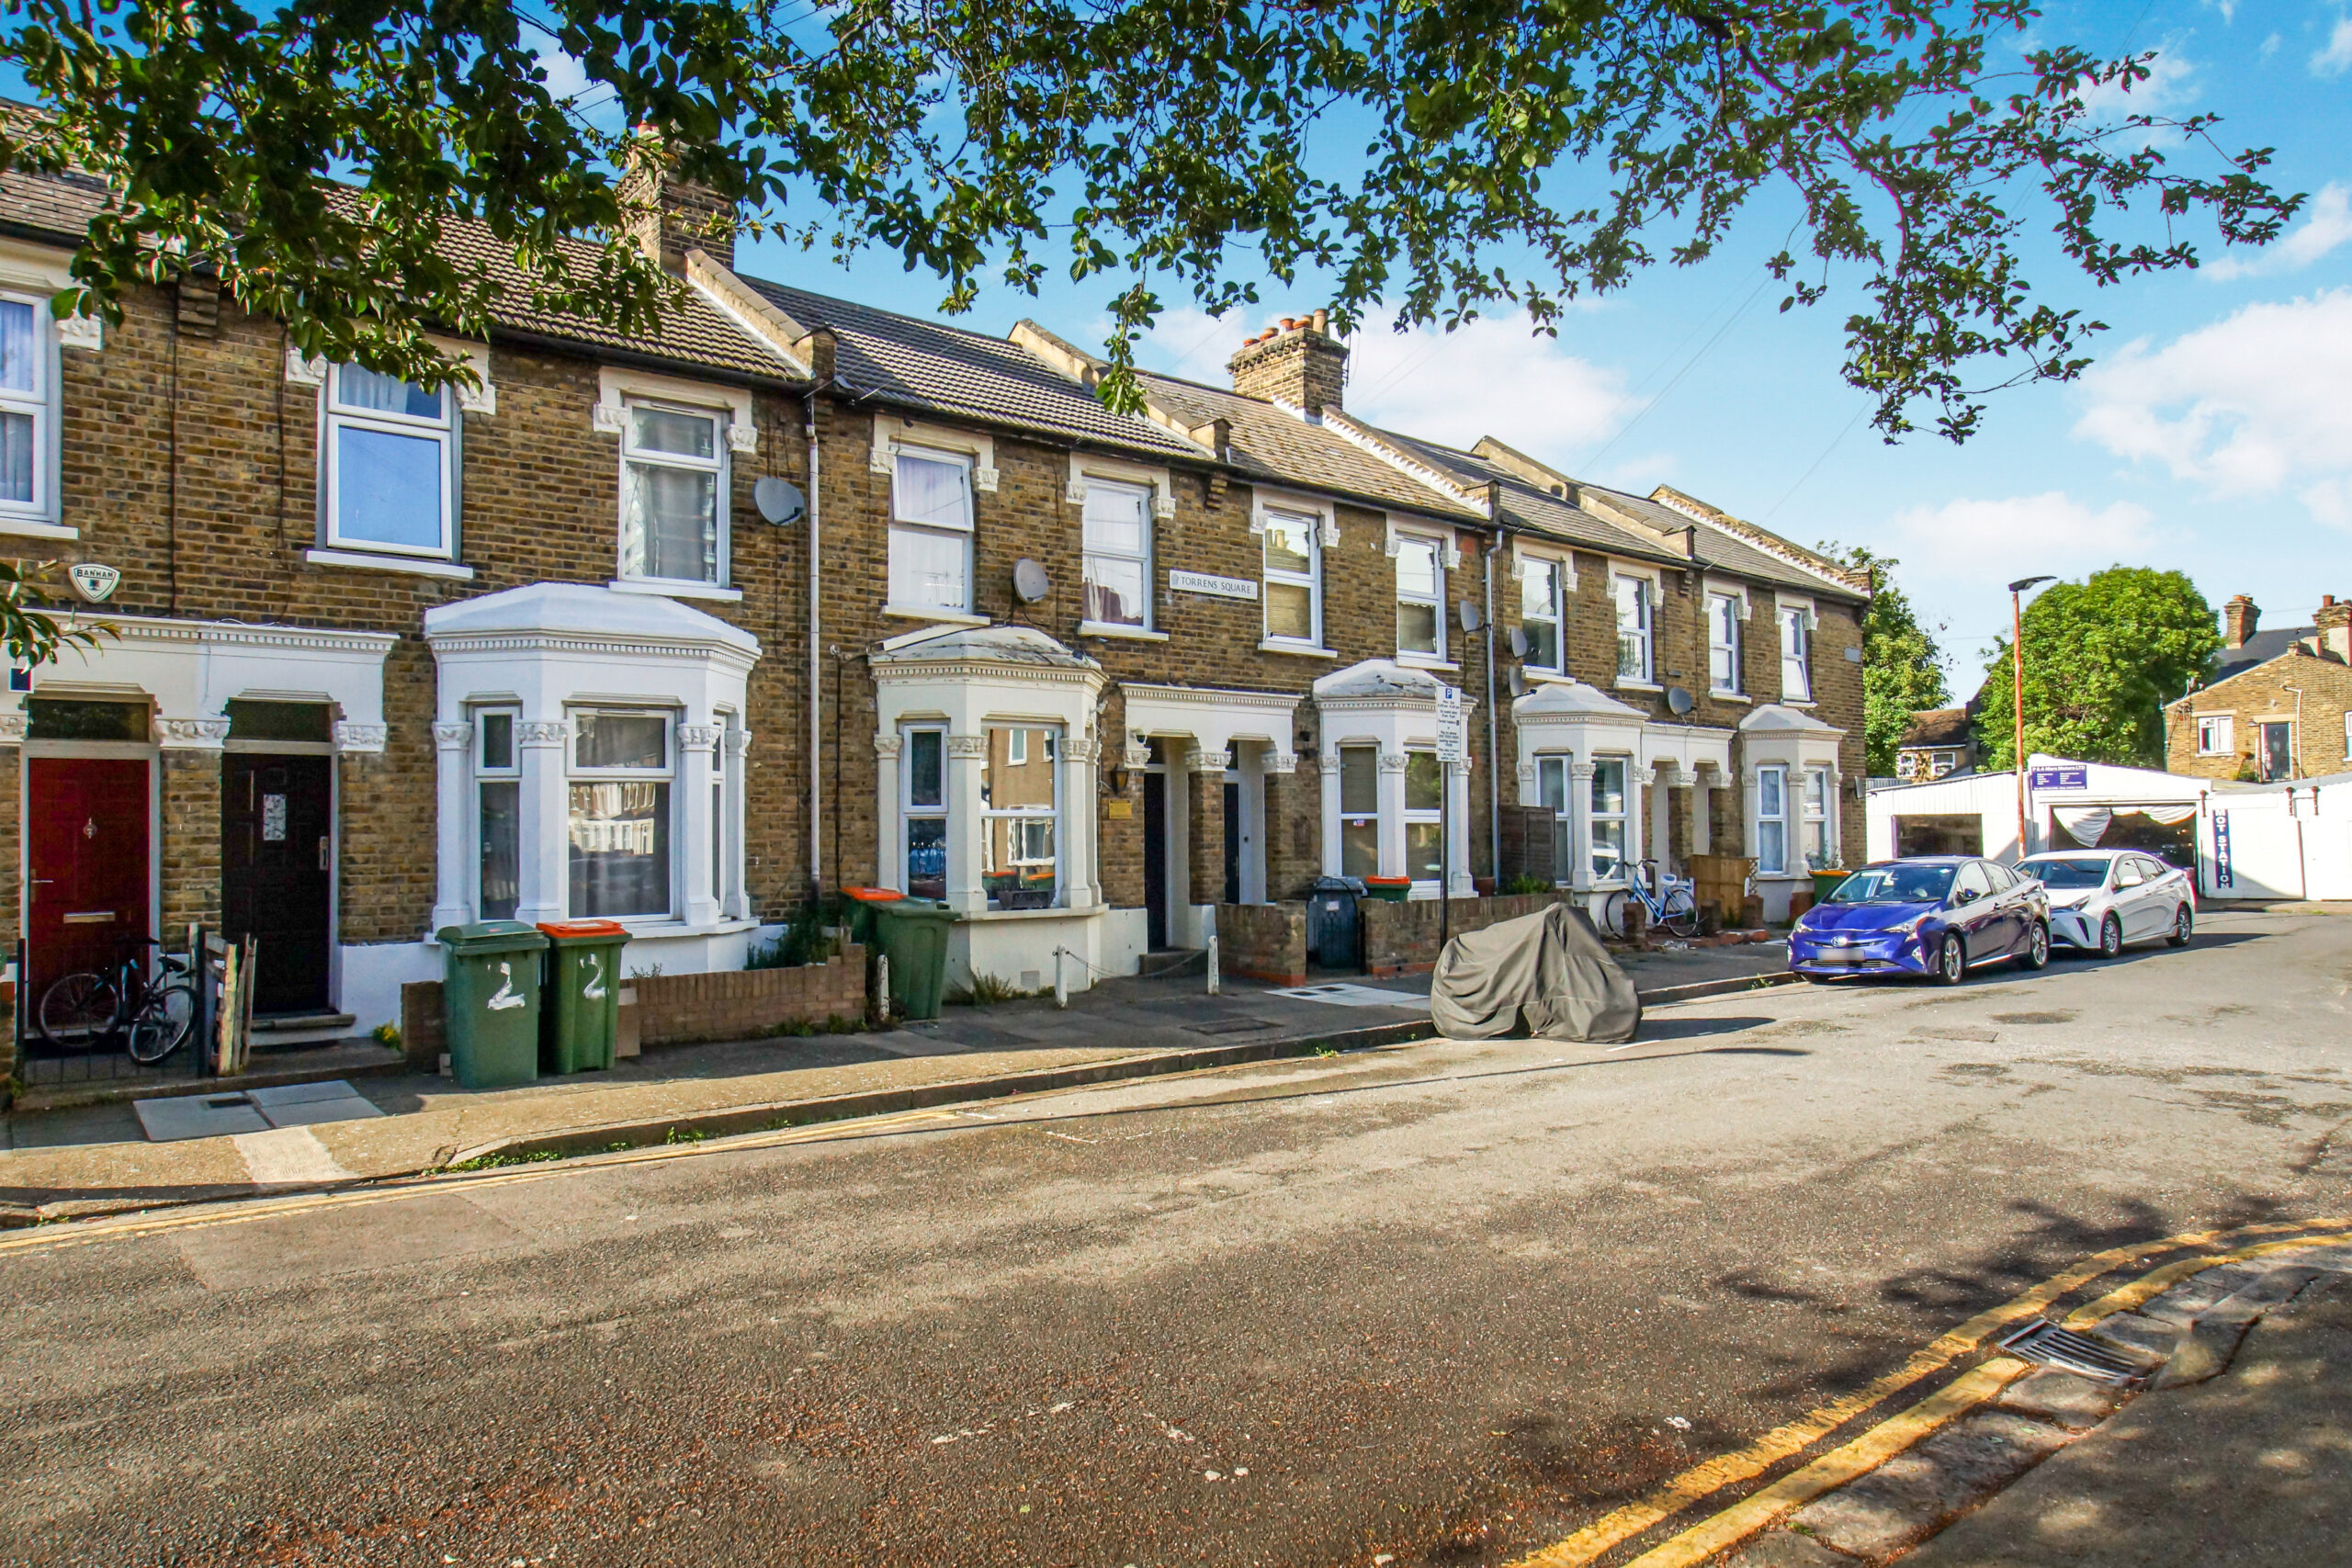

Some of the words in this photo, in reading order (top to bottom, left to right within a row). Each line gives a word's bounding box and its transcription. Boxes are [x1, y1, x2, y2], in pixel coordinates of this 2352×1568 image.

[77, 570, 113, 578] BANHAM
[1181, 576, 1217, 589] TORRENS
[1221, 581, 1250, 594] SQUARE
[1447, 689, 1452, 697] P
[2215, 808, 2227, 832] MOT
[2218, 835, 2230, 889] STATION
[488, 963, 526, 1010] 2
[579, 953, 609, 999] 2
